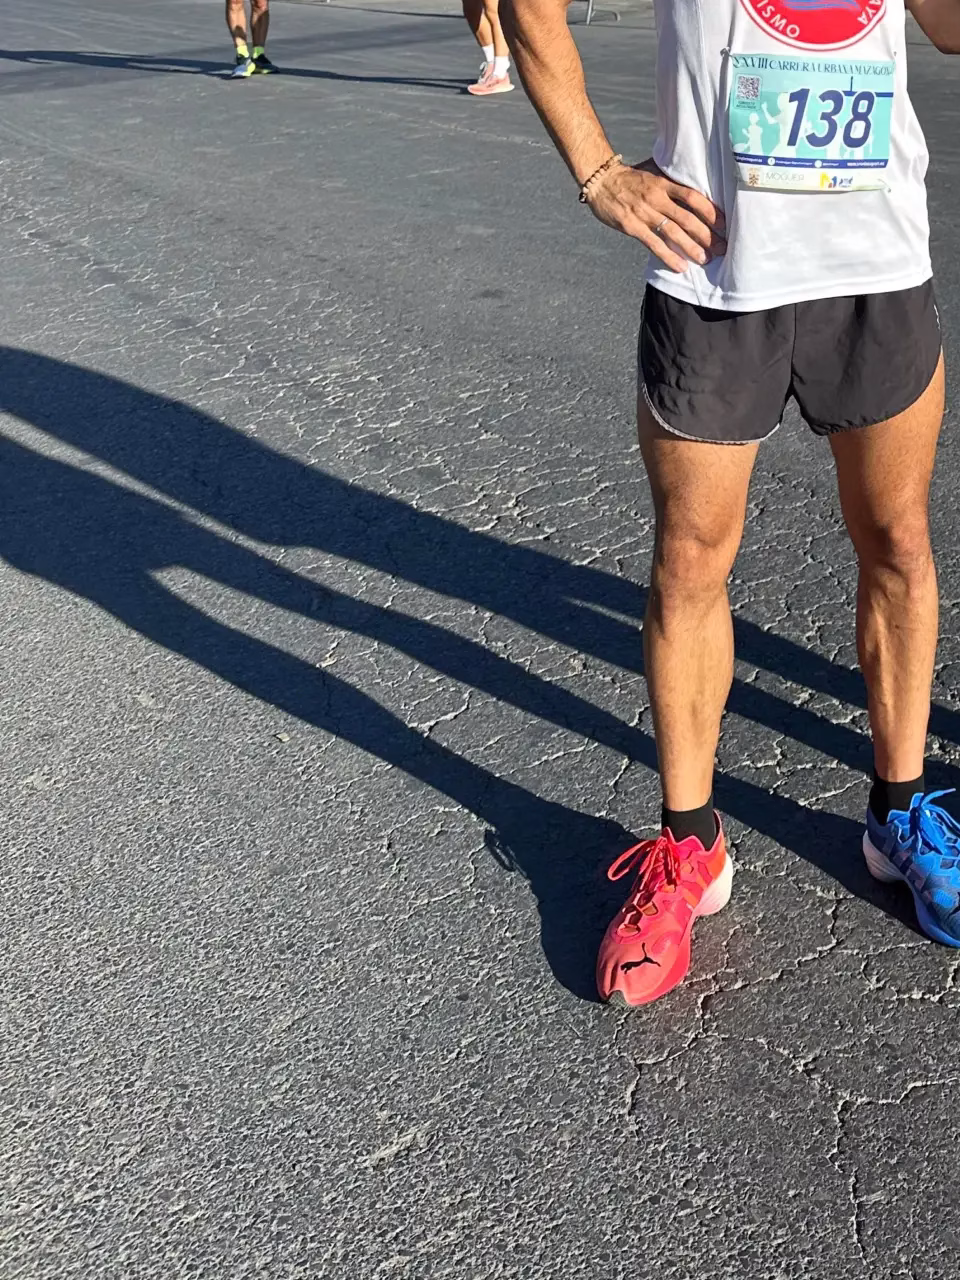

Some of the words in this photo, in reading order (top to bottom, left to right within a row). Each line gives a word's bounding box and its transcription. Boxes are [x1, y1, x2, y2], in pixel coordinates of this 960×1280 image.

[769, 59, 816, 72] CARRERA
[817, 62, 854, 74] URBANA
[787, 88, 875, 148] 138
[765, 172, 805, 182] MOGUER
